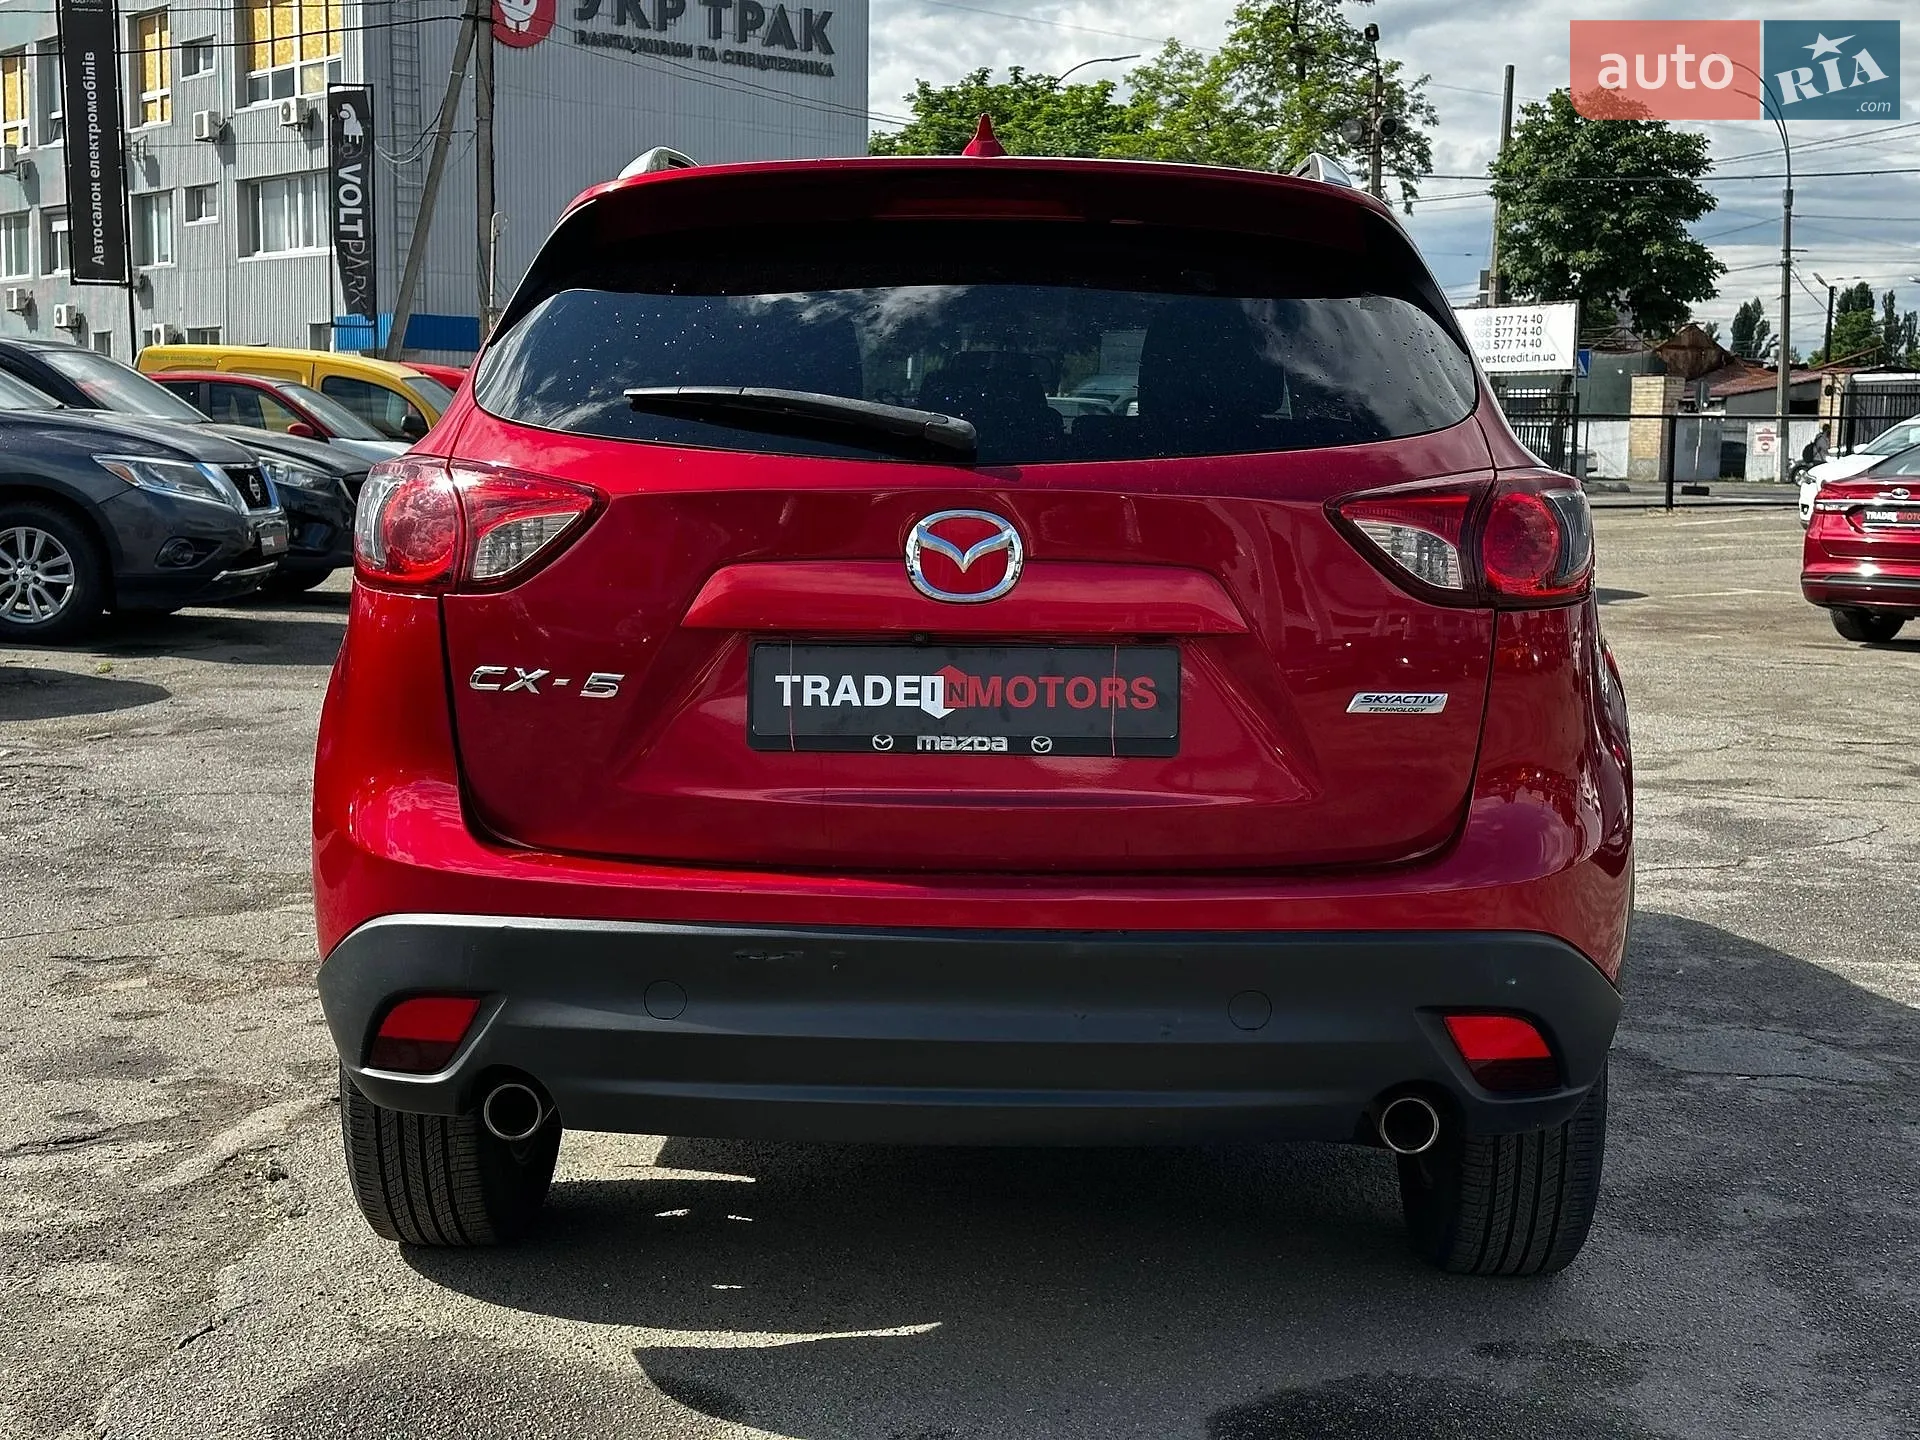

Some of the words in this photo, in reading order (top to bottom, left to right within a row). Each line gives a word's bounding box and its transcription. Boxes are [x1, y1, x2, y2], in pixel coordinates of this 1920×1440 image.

[697, 45, 718, 62] ТА
[82, 51, 102, 178] електромобілів
[91, 182, 105, 265] Автосалон
[1495, 315, 1514, 326] 577
[1516, 314, 1528, 324] 74
[1530, 313, 1543, 324] 40
[1494, 327, 1513, 338] 577
[1515, 327, 1527, 337] 74
[1530, 326, 1543, 336] 40
[1493, 339, 1513, 350] 577
[1515, 339, 1527, 349] 74
[1529, 338, 1542, 348] 40
[1477, 353, 1556, 364] vestcredit.in.ua
[469, 665, 626, 699] CX-5
[775, 675, 921, 707] TRADE
[967, 676, 1157, 709] MOTORS
[1361, 695, 1440, 704] SKYACTIV
